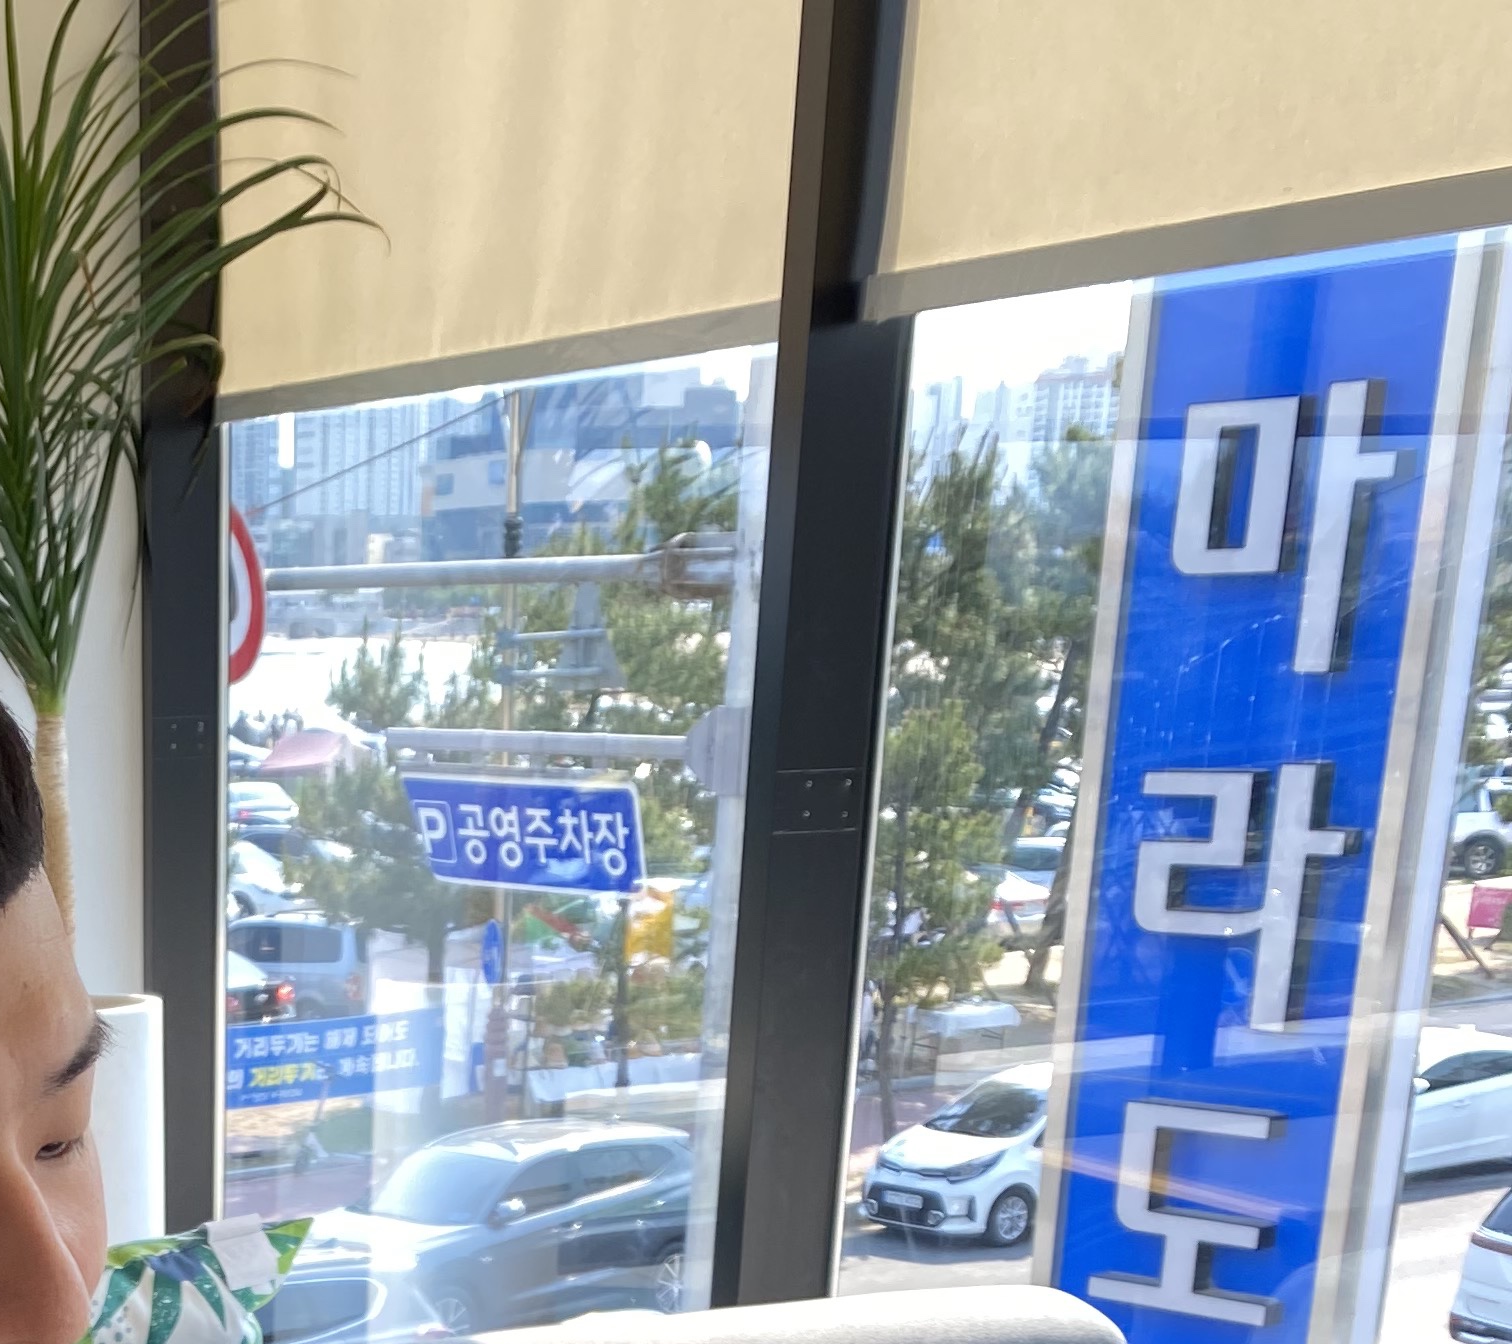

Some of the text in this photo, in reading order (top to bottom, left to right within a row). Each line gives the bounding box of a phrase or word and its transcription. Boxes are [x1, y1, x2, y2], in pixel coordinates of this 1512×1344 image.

[417, 803, 630, 878] P 공영주차장
[1088, 378, 1400, 1326] 마라도
[234, 1033, 319, 1058] 거리두기는
